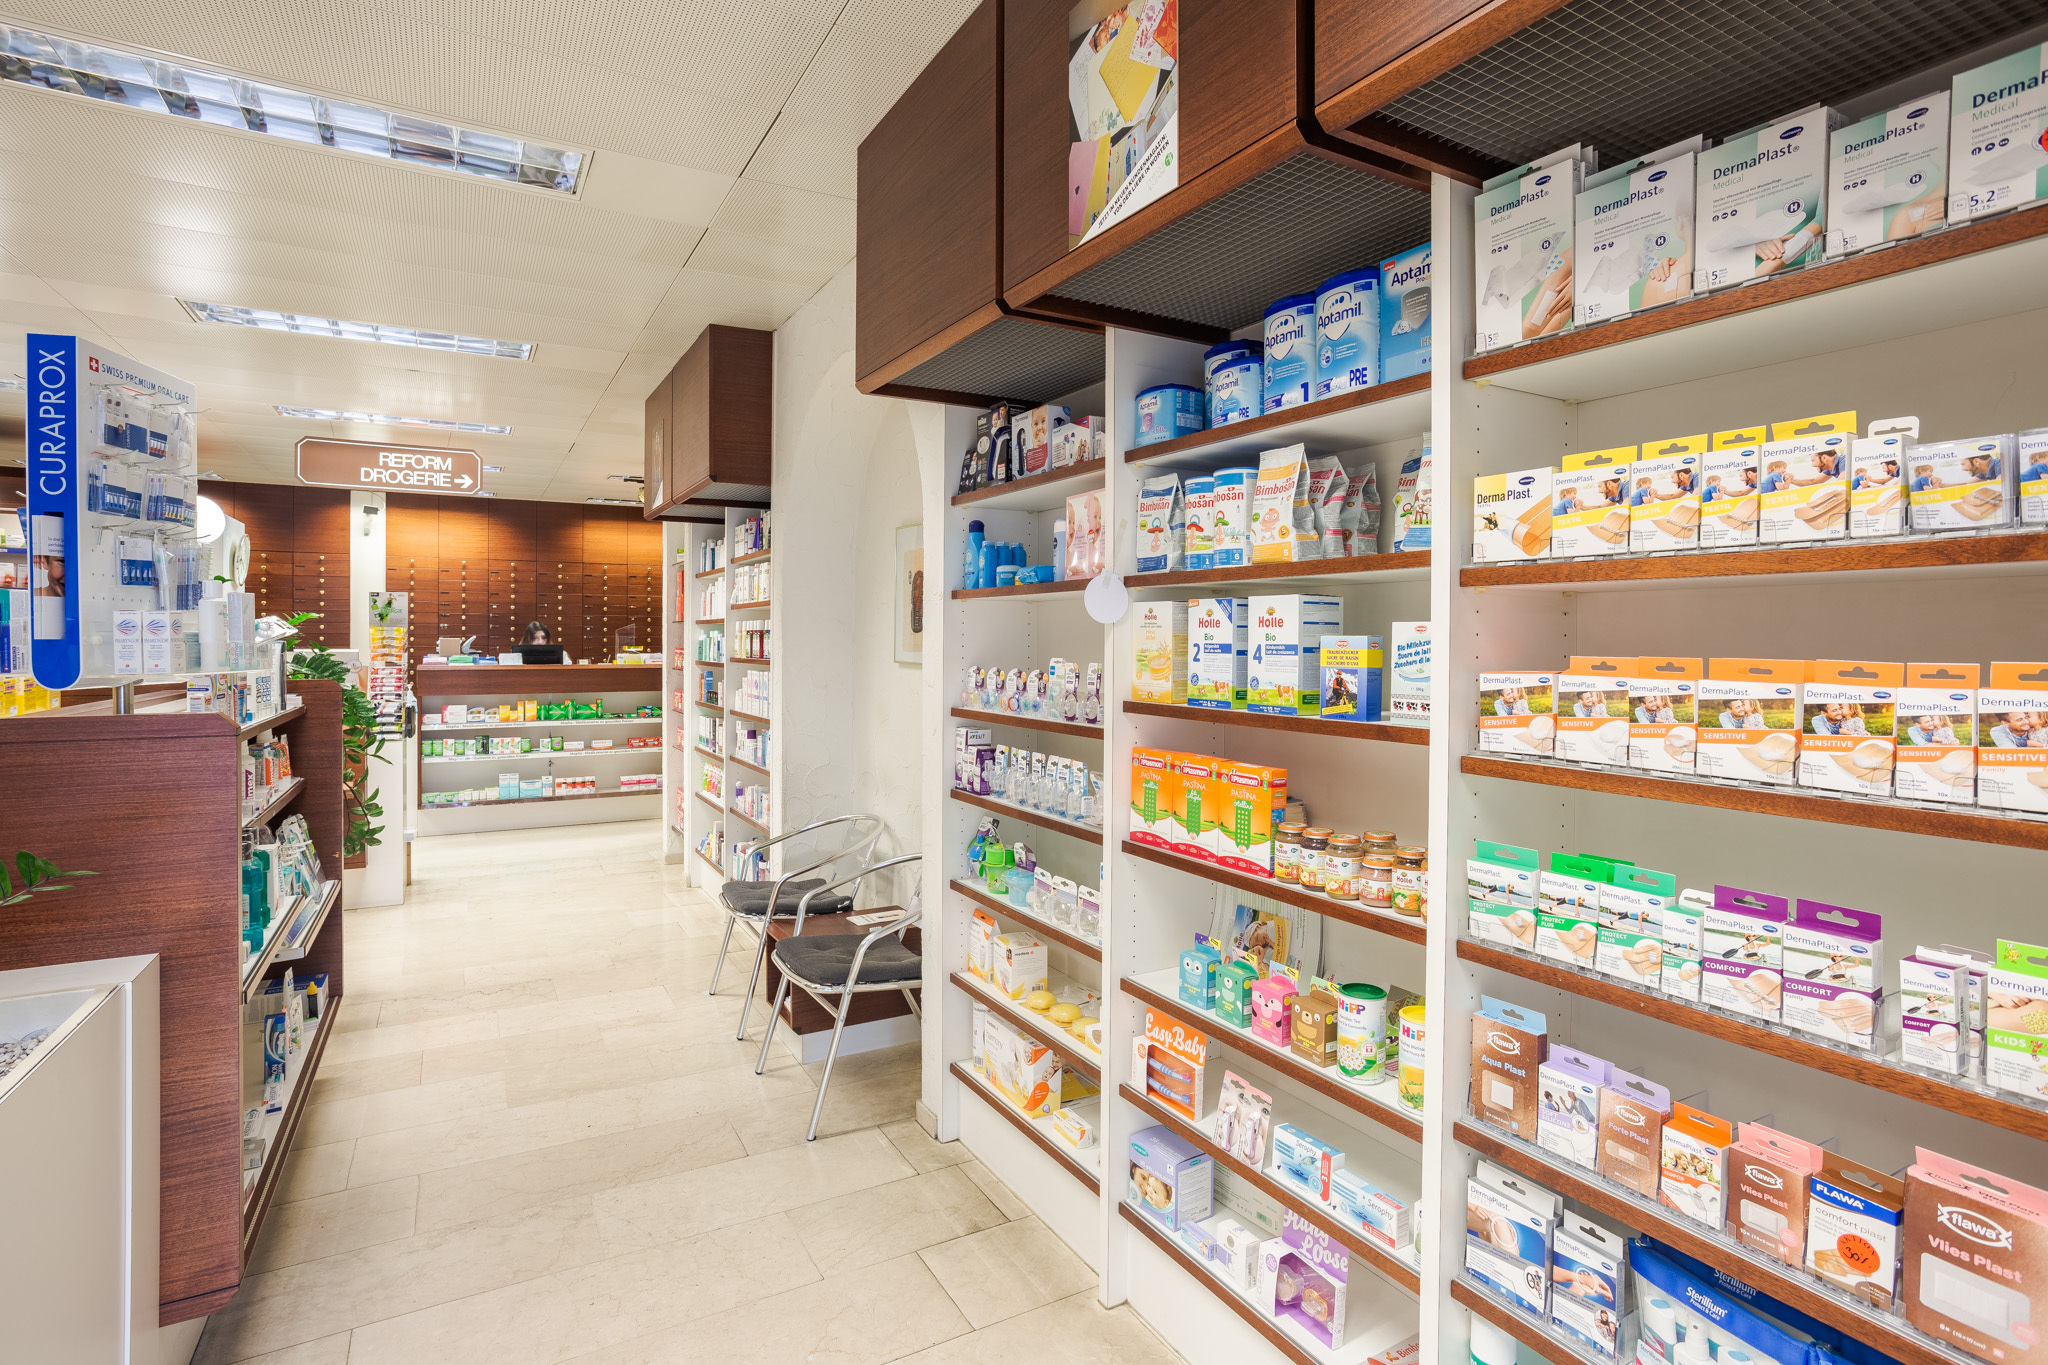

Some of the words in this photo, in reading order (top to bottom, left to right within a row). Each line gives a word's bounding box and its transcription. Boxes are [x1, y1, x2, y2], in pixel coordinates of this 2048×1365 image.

[1972, 97, 2019, 122] Medical
[1844, 148, 1873, 164] Medical
[1712, 174, 1744, 192] Medical
[1490, 212, 1512, 227] Medical
[1593, 211, 1620, 227] Medical
[1711, 270, 1718, 281] 5
[1317, 302, 1362, 331] Aptamil
[1265, 324, 1305, 350] Aptamil
[101, 363, 124, 380] SWISS
[1349, 366, 1368, 388] PRE
[1215, 377, 1239, 394] Aptamil
[1300, 381, 1309, 402] 1
[1238, 406, 1250, 419] PRE
[38, 349, 67, 496] CURAPROX
[378, 451, 453, 472] REFORM
[359, 466, 453, 488] DROGERIE
[1255, 480, 1295, 497] Bimbosan
[1477, 492, 1506, 505] Derma
[1765, 492, 1800, 505] TEXTIL
[1913, 493, 1943, 502] TEXTIL
[1139, 500, 1170, 513] Bimbosan
[1634, 506, 1662, 518] TEXTIL
[1703, 502, 1733, 514] TEXTIL
[1557, 515, 1583, 526] TEXTIL
[1198, 616, 1221, 629] Holle
[1257, 615, 1284, 629] Holle
[1204, 633, 1215, 641] Bio
[1265, 633, 1277, 642] Bio
[1192, 642, 1201, 663] 2
[1252, 643, 1263, 665] 4
[1483, 718, 1518, 727] SENSITIVE
[1561, 720, 1594, 728] SENSITIVE
[1630, 726, 1667, 735] SENSITIVE
[1703, 732, 1747, 740] SENSITIVE
[1803, 738, 1854, 748] SENSITIVE
[1142, 759, 1163, 769] Plasmon
[1981, 752, 2047, 763] SENSITIVE
[1140, 771, 1162, 781] PASTINA
[1185, 766, 1209, 777] Plasmon
[1981, 766, 2006, 774] Family
[1183, 779, 1207, 791] PASTINA
[1233, 774, 1260, 787] Plasmon
[1231, 788, 1257, 801] PASTINA
[1396, 875, 1413, 884] Holle
[1472, 901, 1496, 911] PROTECT
[1473, 905, 1487, 913] PLUS
[1540, 915, 1566, 925] PROTECT
[1540, 920, 1555, 928] PLUS
[1600, 930, 1628, 940] PROTECT
[1600, 935, 1616, 943] PLUS
[1663, 956, 1684, 965] PROTECT
[1705, 961, 1747, 975] COMFORT
[1785, 981, 1832, 998] COMFORT
[1904, 1019, 1931, 1028] COMFORT
[1993, 1034, 2027, 1048] KIDS
[1481, 1054, 1502, 1069] Aqua
[1504, 1062, 1526, 1078] Plast
[1541, 1109, 1558, 1118] SOFT
[1541, 1114, 1571, 1130] SILICONE
[1608, 1122, 1629, 1136] Forte
[1629, 1131, 1650, 1145] Plast
[1295, 1139, 1317, 1157] Serophy
[1663, 1169, 1685, 1181] ISOPOR
[1740, 1183, 1763, 1199] Vlies
[1763, 1192, 1789, 1210] Plast
[1366, 1198, 1394, 1221] Serophy
[1363, 1225, 1373, 1234] +1
[1815, 1207, 1858, 1231] comfort
[1859, 1225, 1888, 1242] plast
[1927, 1234, 1971, 1262] Vlies
[1973, 1253, 2023, 1284] Plast
[1718, 1278, 1735, 1293] Protect
[1739, 1288, 1752, 1299] Care
[1689, 1297, 1706, 1313] Protect
[1708, 1309, 1721, 1321] Care
